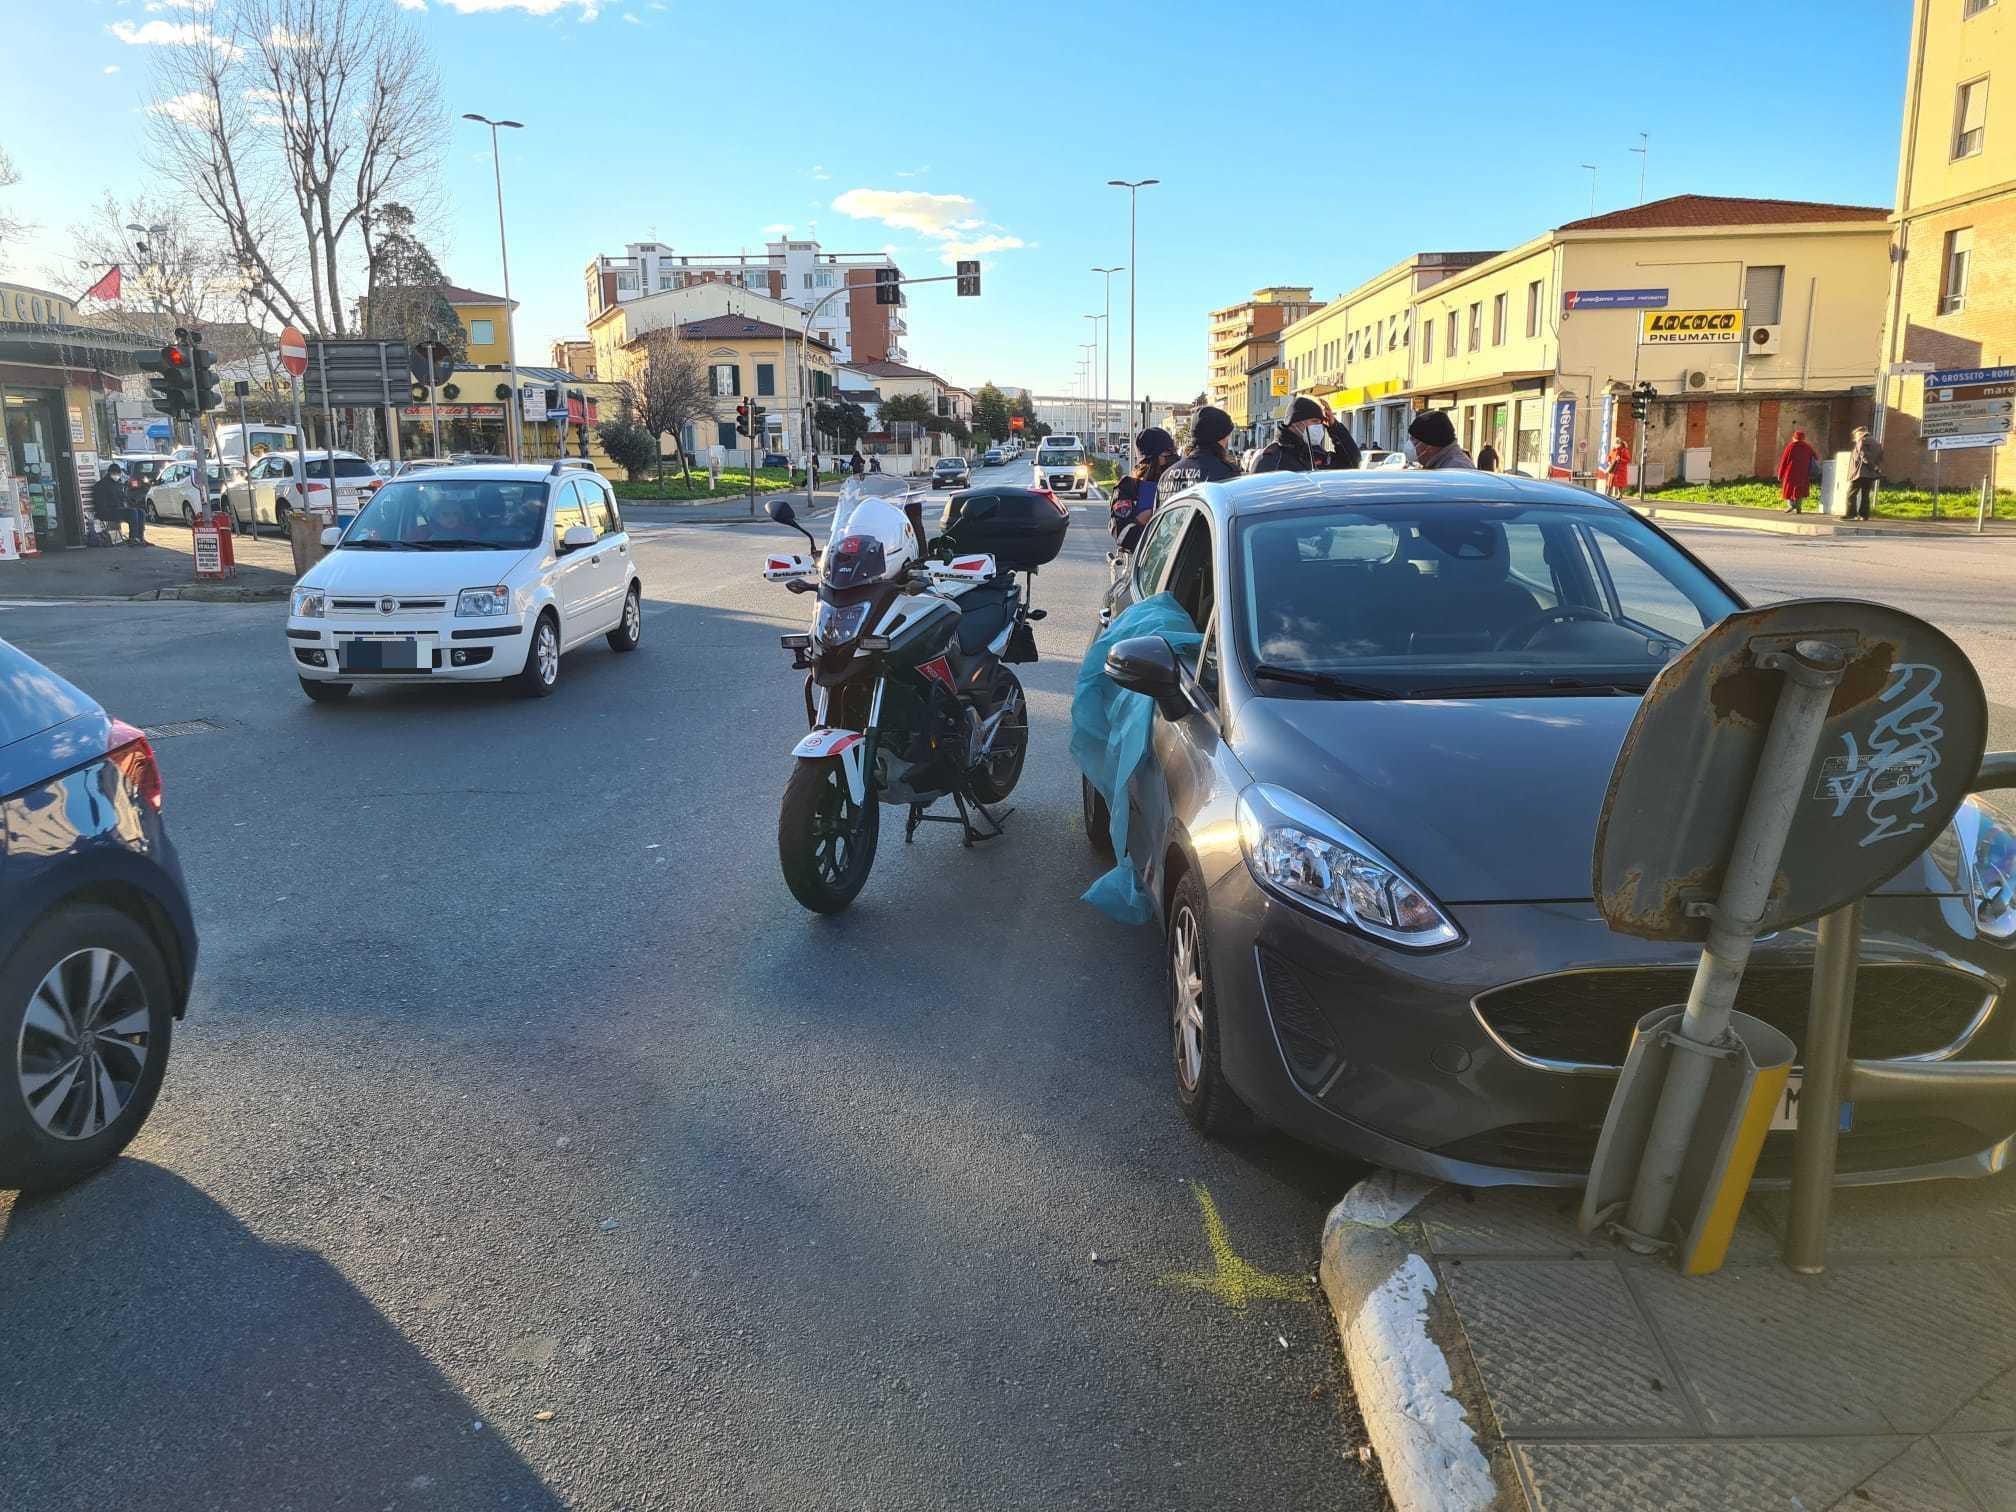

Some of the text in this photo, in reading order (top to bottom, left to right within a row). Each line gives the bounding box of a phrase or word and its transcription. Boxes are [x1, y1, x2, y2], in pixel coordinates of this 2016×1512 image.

[1651, 314, 1736, 331] LOCOCO
[1650, 332, 1736, 342] PNEUMATICI
[1942, 372, 1984, 382] GROSSETO
[1983, 386, 2015, 396] mare
[1168, 468, 1201, 480] POLIZIA
